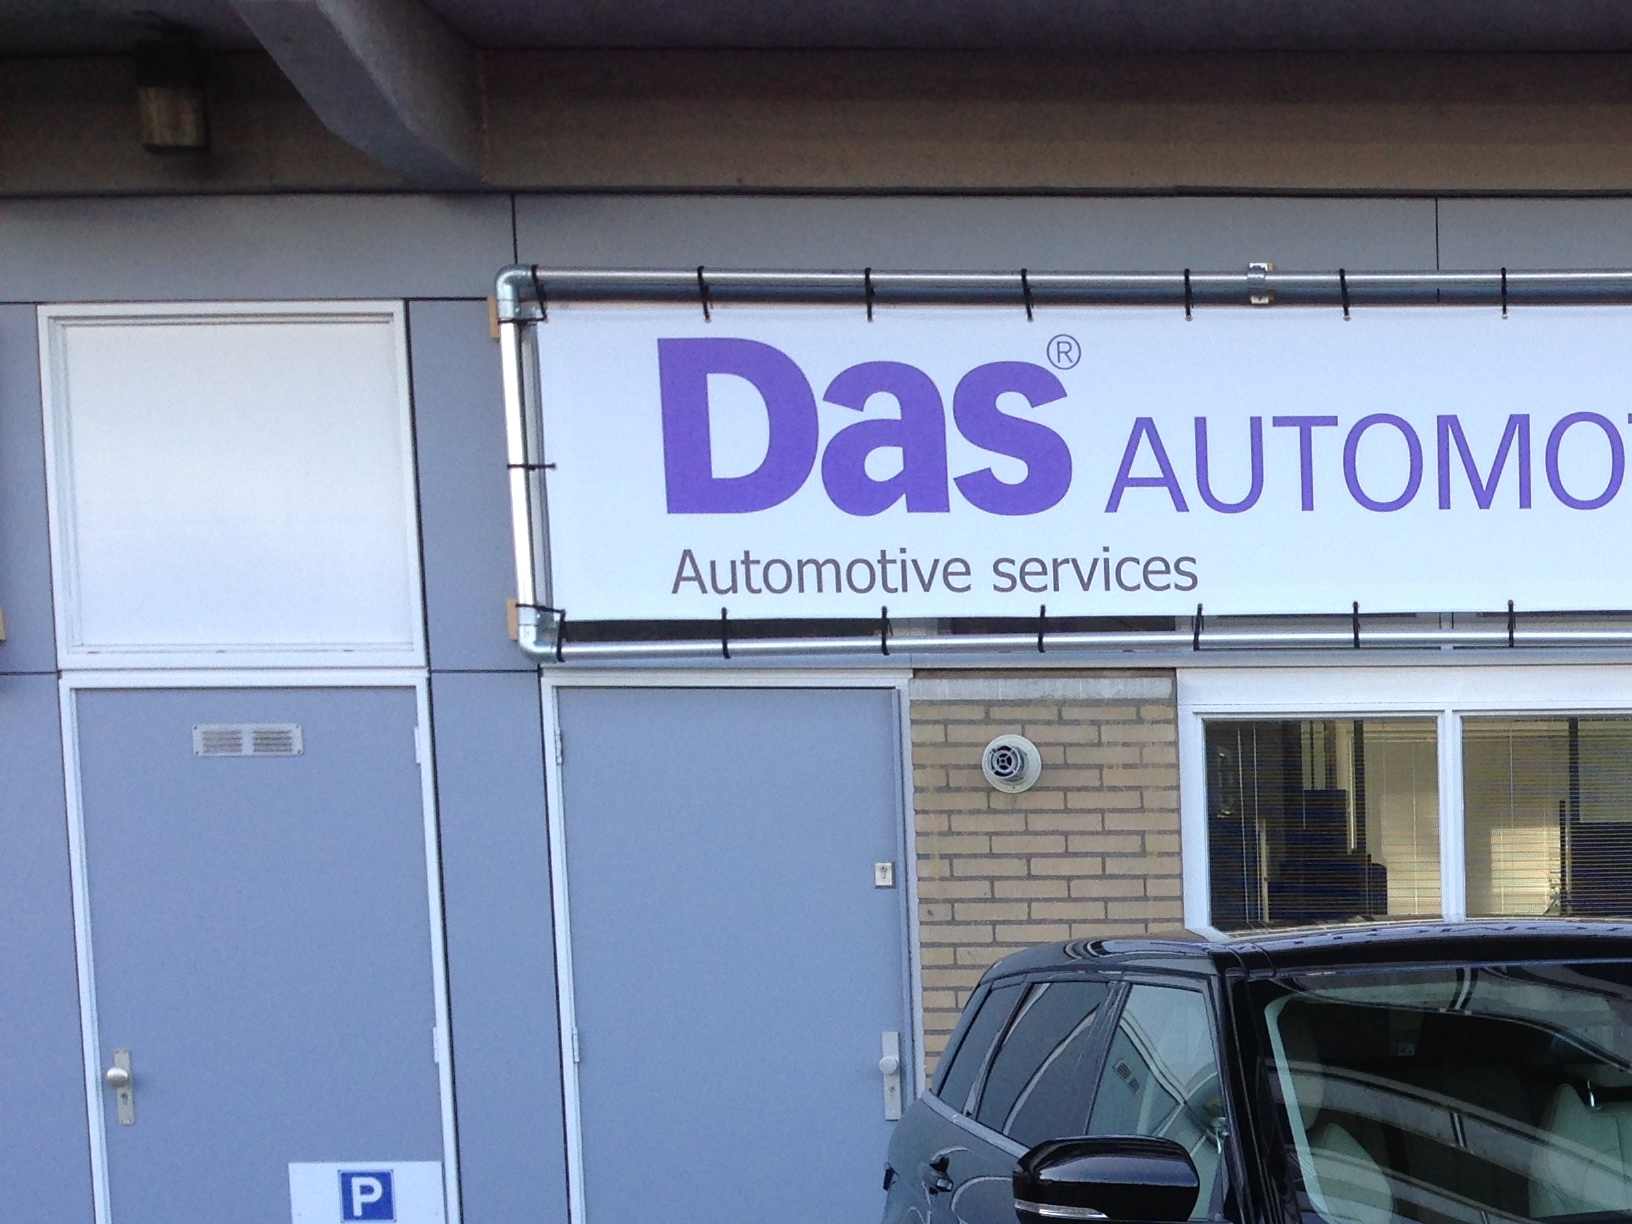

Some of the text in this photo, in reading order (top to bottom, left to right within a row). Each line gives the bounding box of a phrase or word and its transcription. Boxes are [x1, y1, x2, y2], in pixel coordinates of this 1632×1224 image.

[671, 545, 1199, 595] Automotive services
[350, 1175, 384, 1218] P
